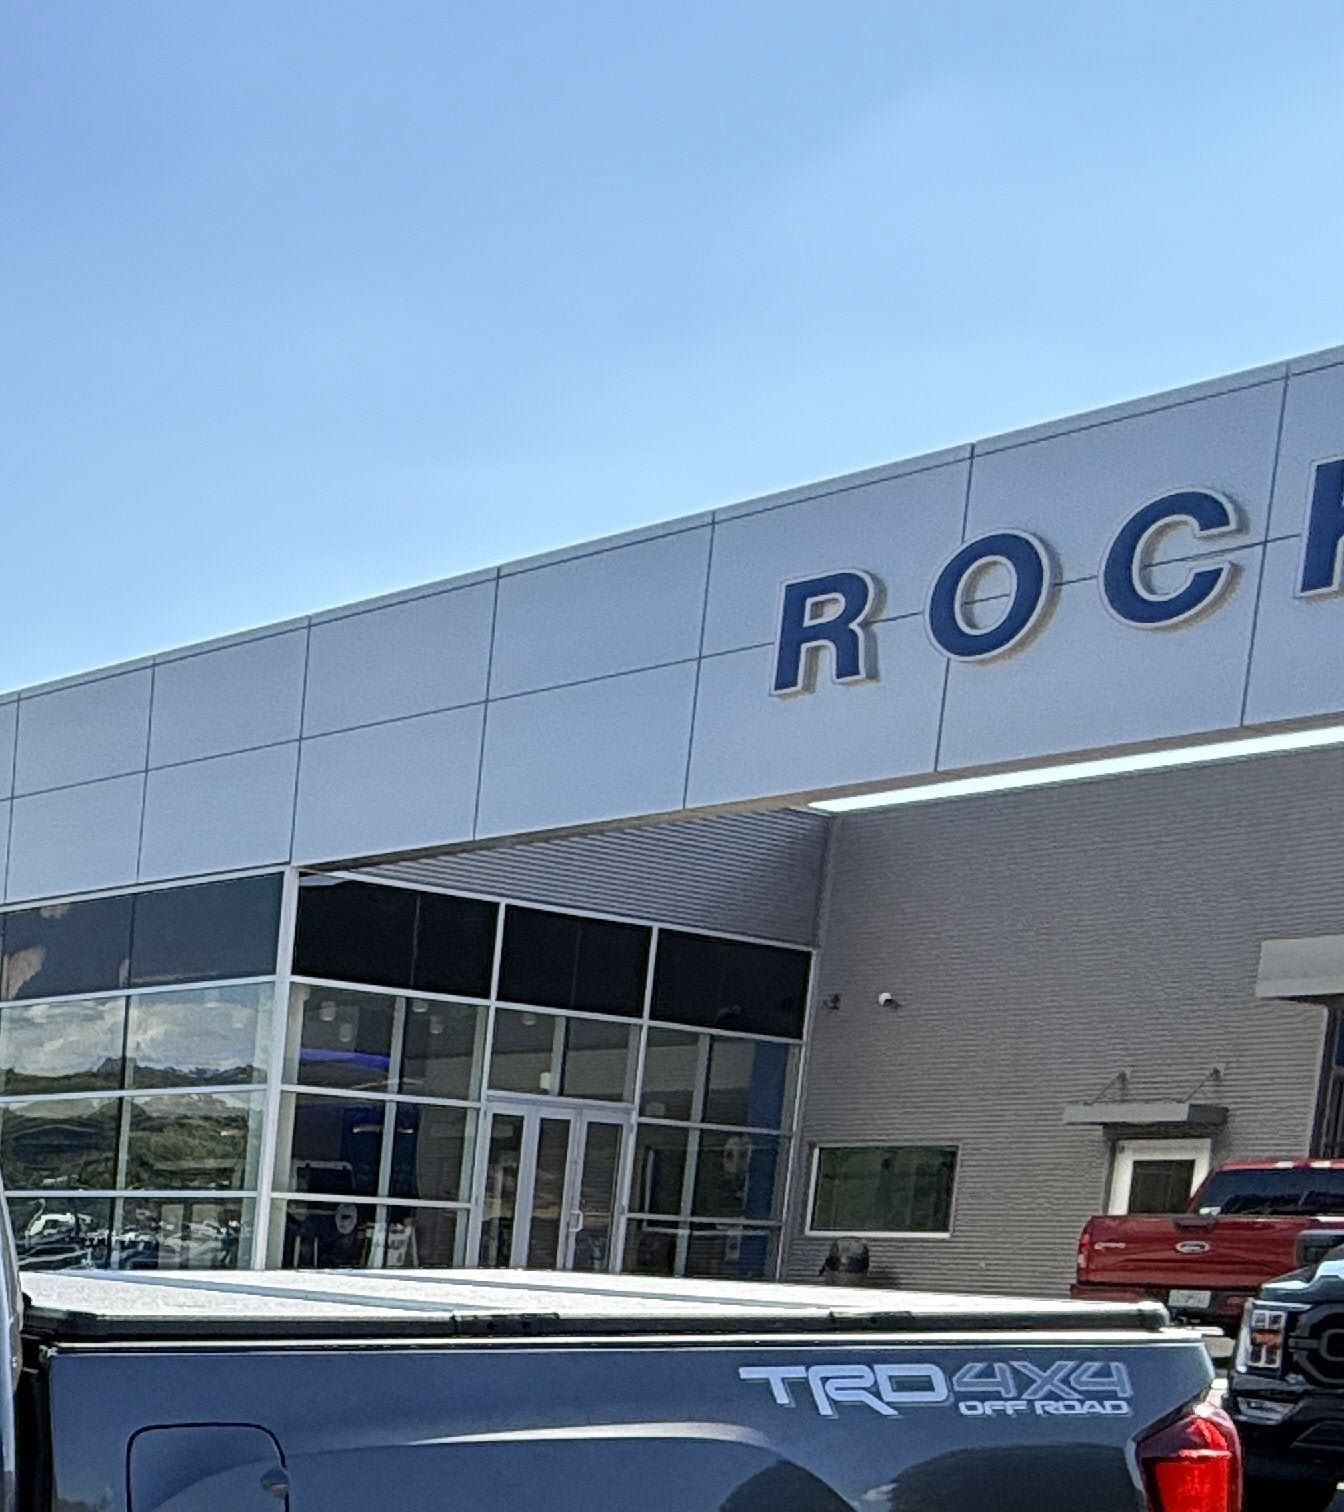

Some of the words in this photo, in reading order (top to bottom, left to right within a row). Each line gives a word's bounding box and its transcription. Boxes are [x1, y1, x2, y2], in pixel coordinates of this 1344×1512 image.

[739, 1364, 951, 1417] TRD
[958, 1400, 1031, 1416] OFF
[1034, 1400, 1132, 1416] ROAD
